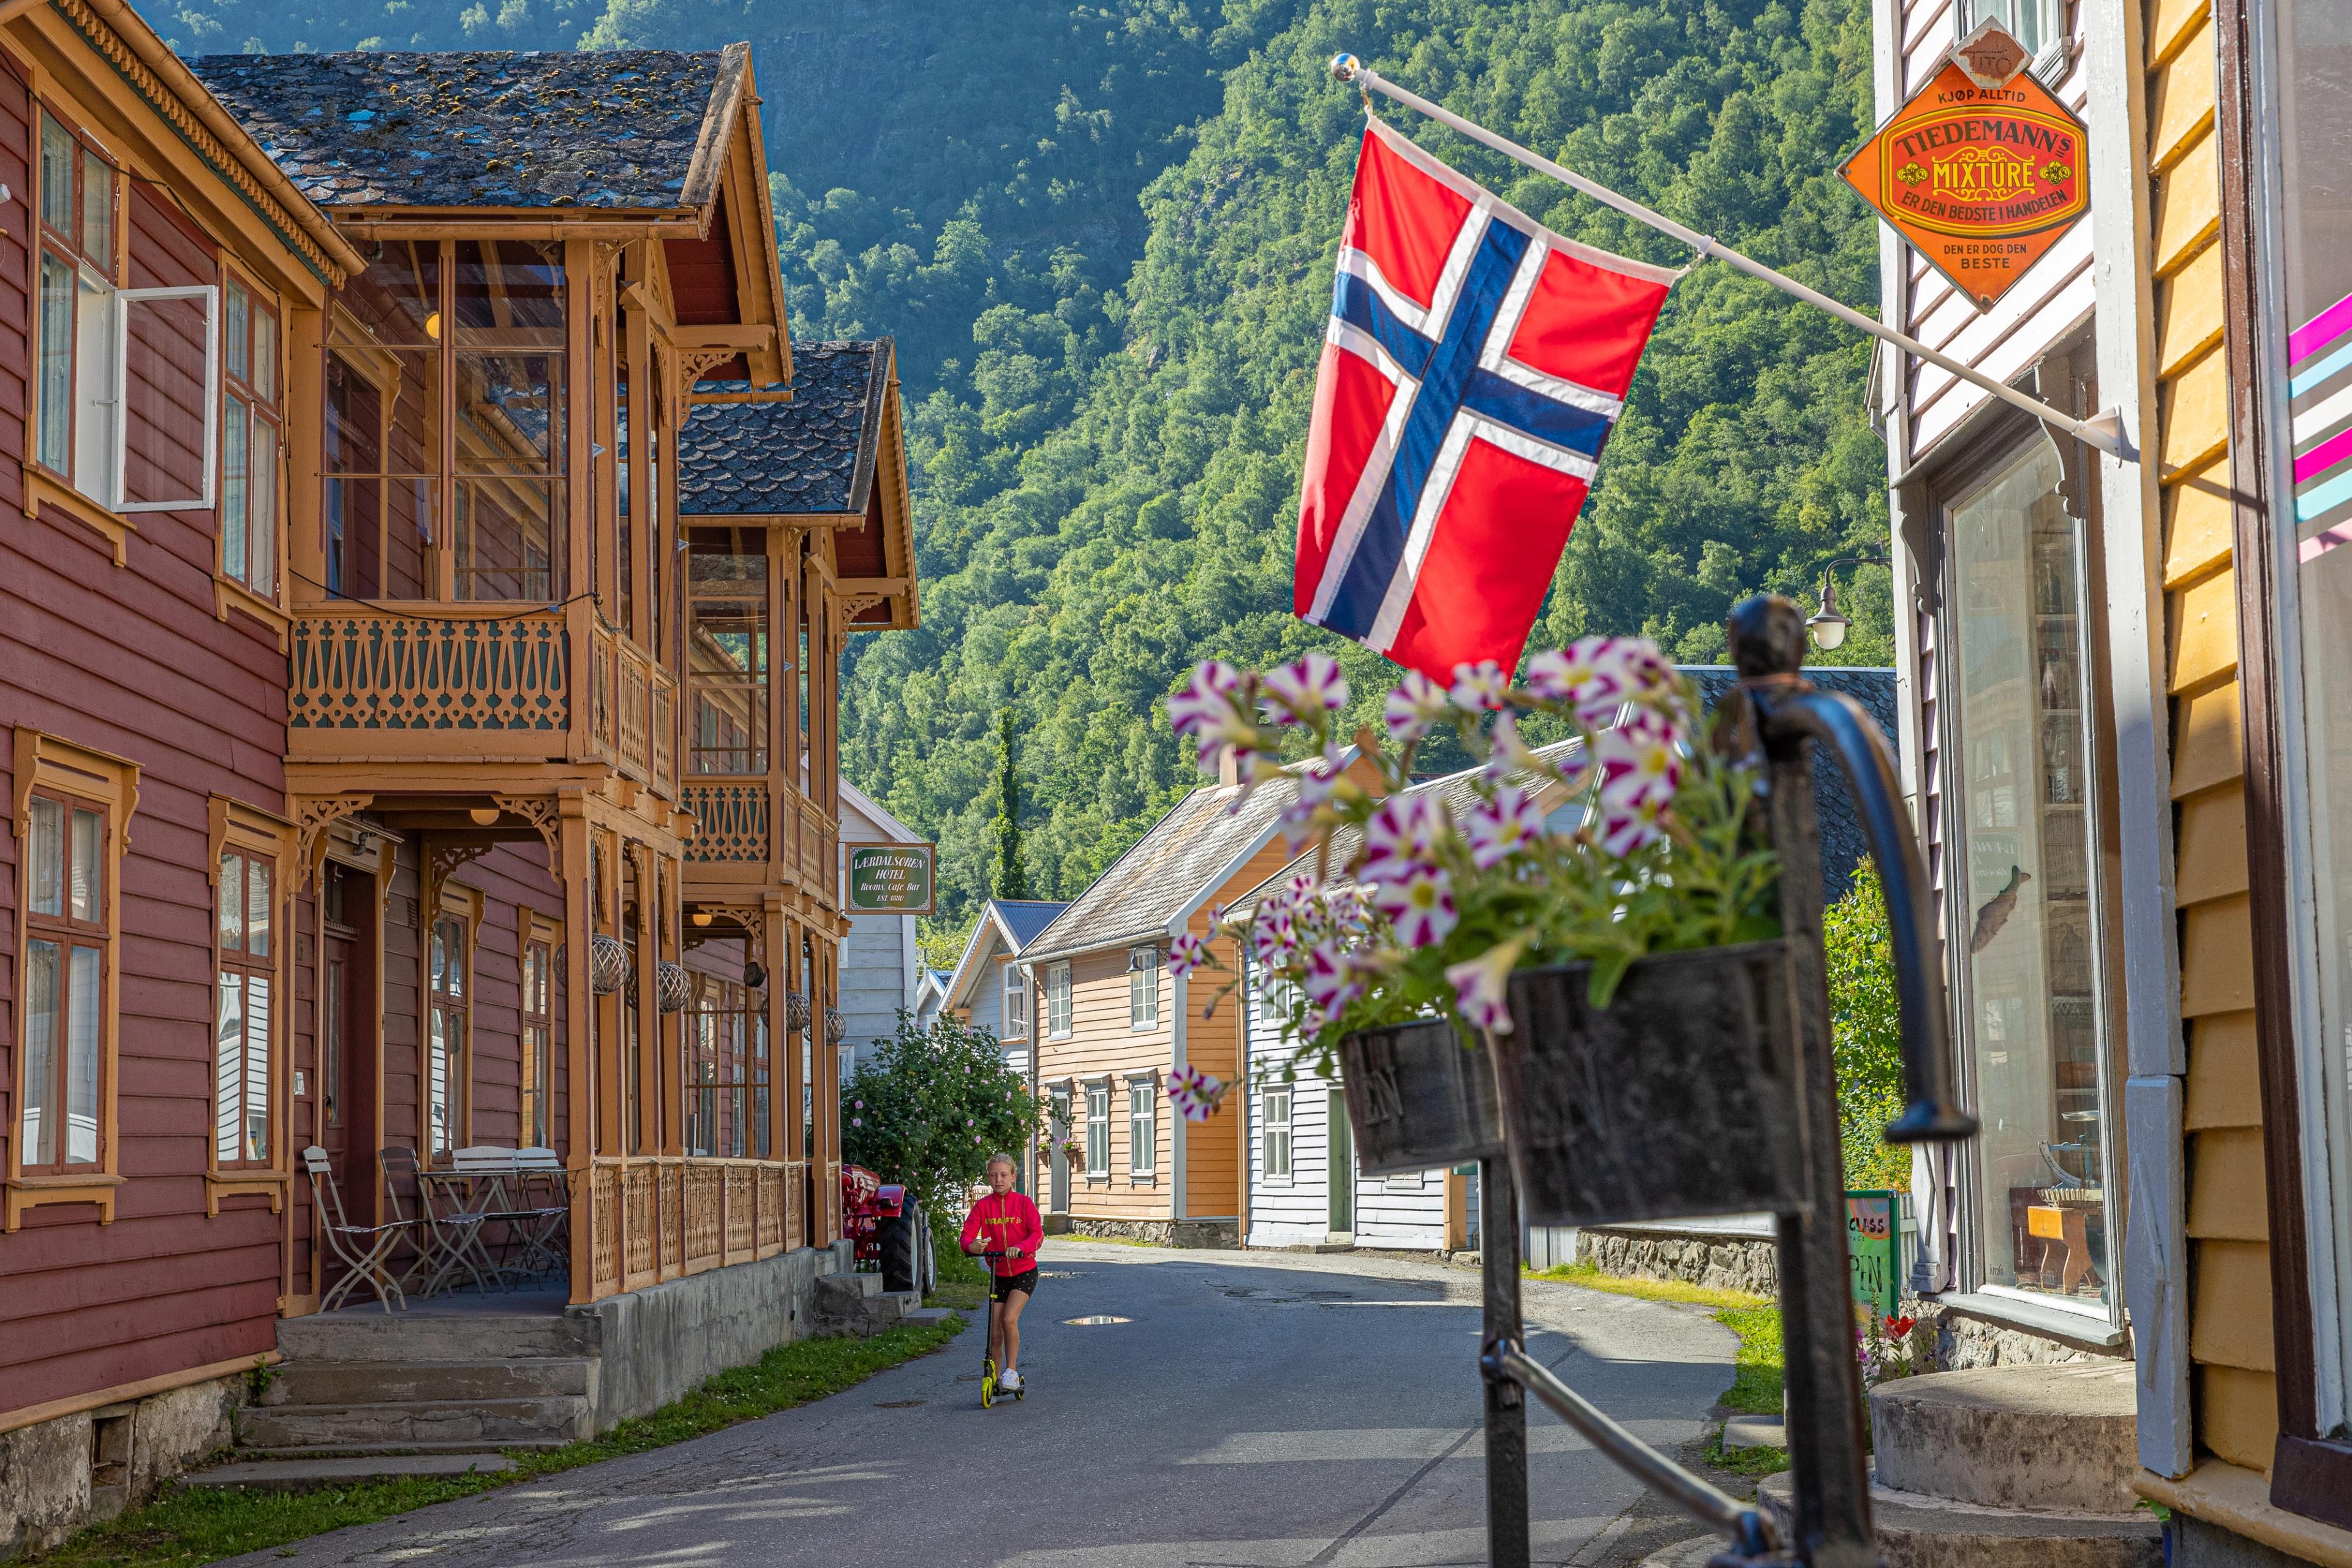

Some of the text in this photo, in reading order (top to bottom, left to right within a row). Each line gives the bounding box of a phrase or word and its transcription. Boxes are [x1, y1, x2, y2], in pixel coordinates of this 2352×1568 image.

[1938, 89, 2026, 104] KJØP ALLTID
[1932, 161, 2035, 189] MIXTURE
[1902, 189, 2068, 221] ER DEN BEDSTE I HANDELEN
[1944, 244, 2027, 255] DEN ER DOG DEN
[1961, 257, 2010, 270] BESTE
[854, 856, 925, 870] LÆRDALSØREN
[875, 870, 906, 880] HOTEL
[861, 883, 886, 891] Rooms.
[907, 883, 921, 891] Bar
[985, 1216, 1015, 1225] CRAFT
[1849, 1254, 1883, 1293] PEN
